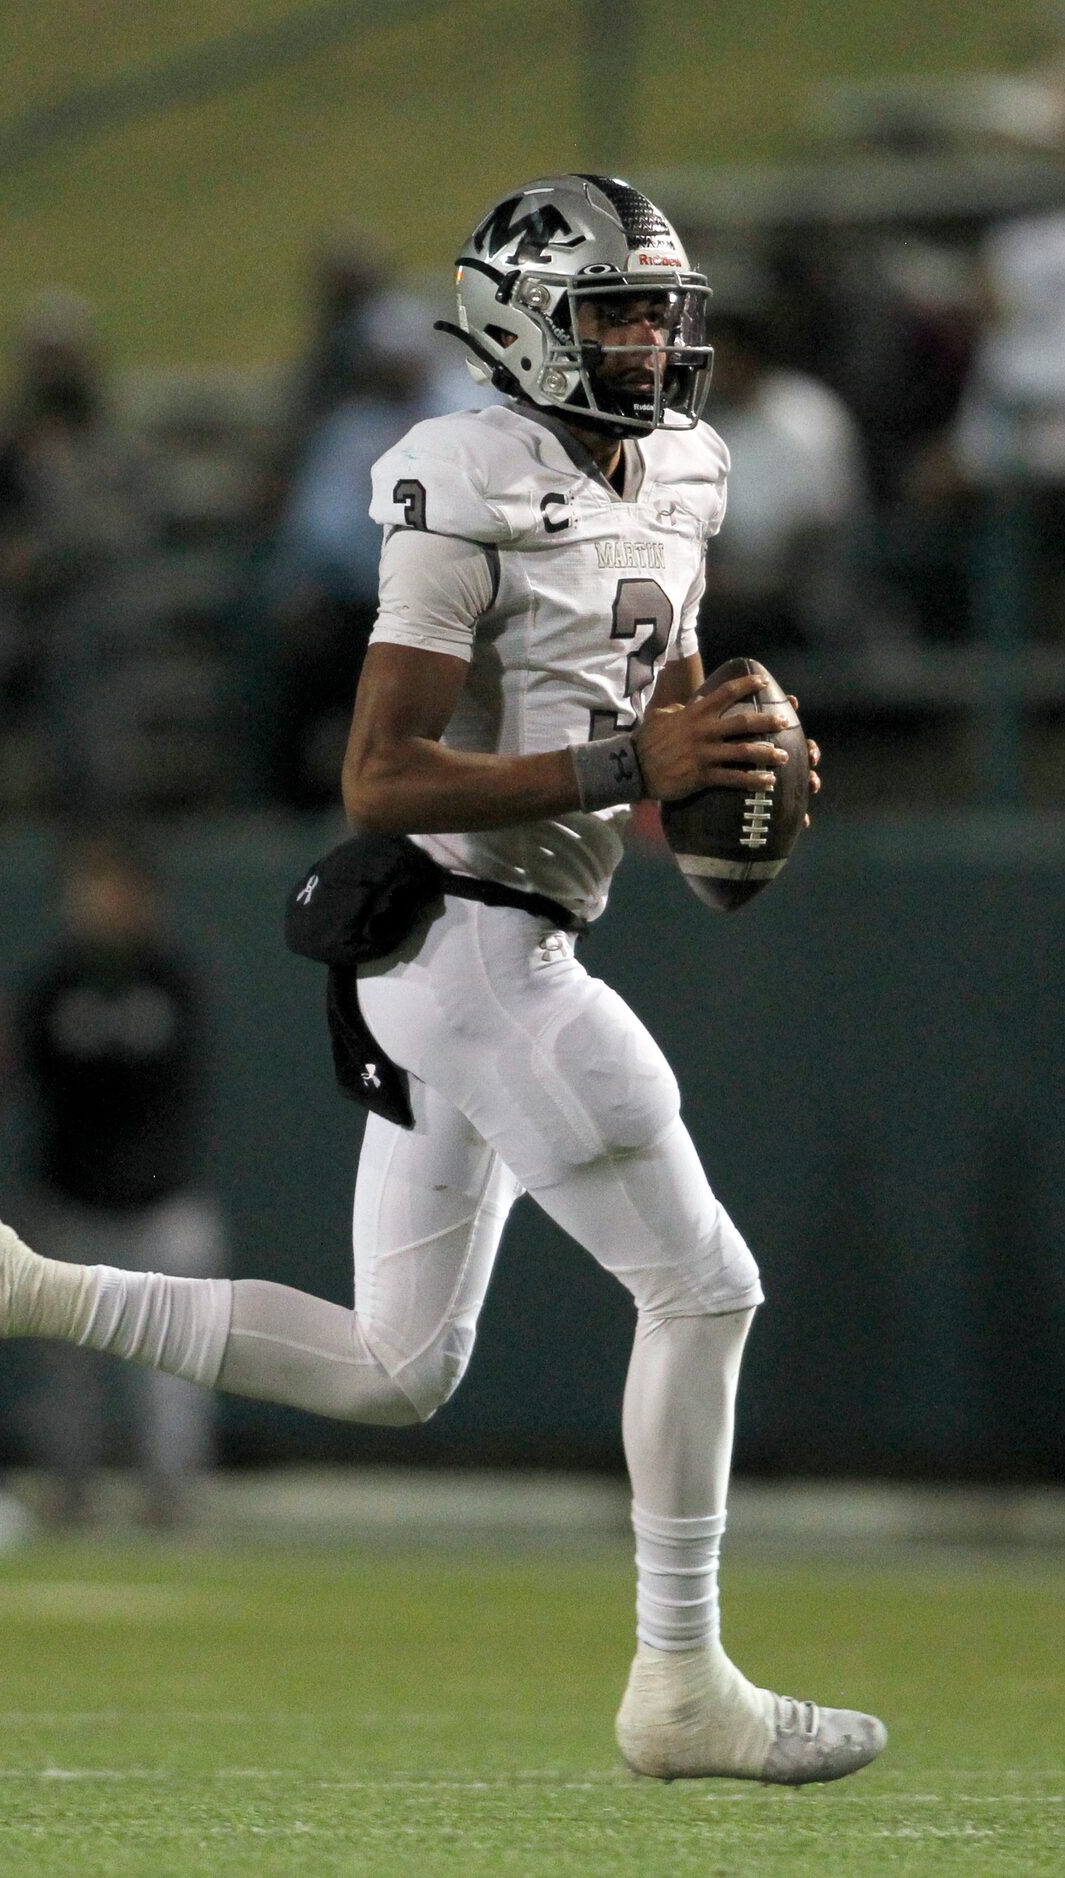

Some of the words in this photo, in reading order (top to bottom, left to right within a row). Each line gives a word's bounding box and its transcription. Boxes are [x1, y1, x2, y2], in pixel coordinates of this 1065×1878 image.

[393, 479, 427, 529] 3
[540, 492, 572, 534] C
[594, 542, 666, 569] MARTIN
[589, 578, 674, 742] 3
